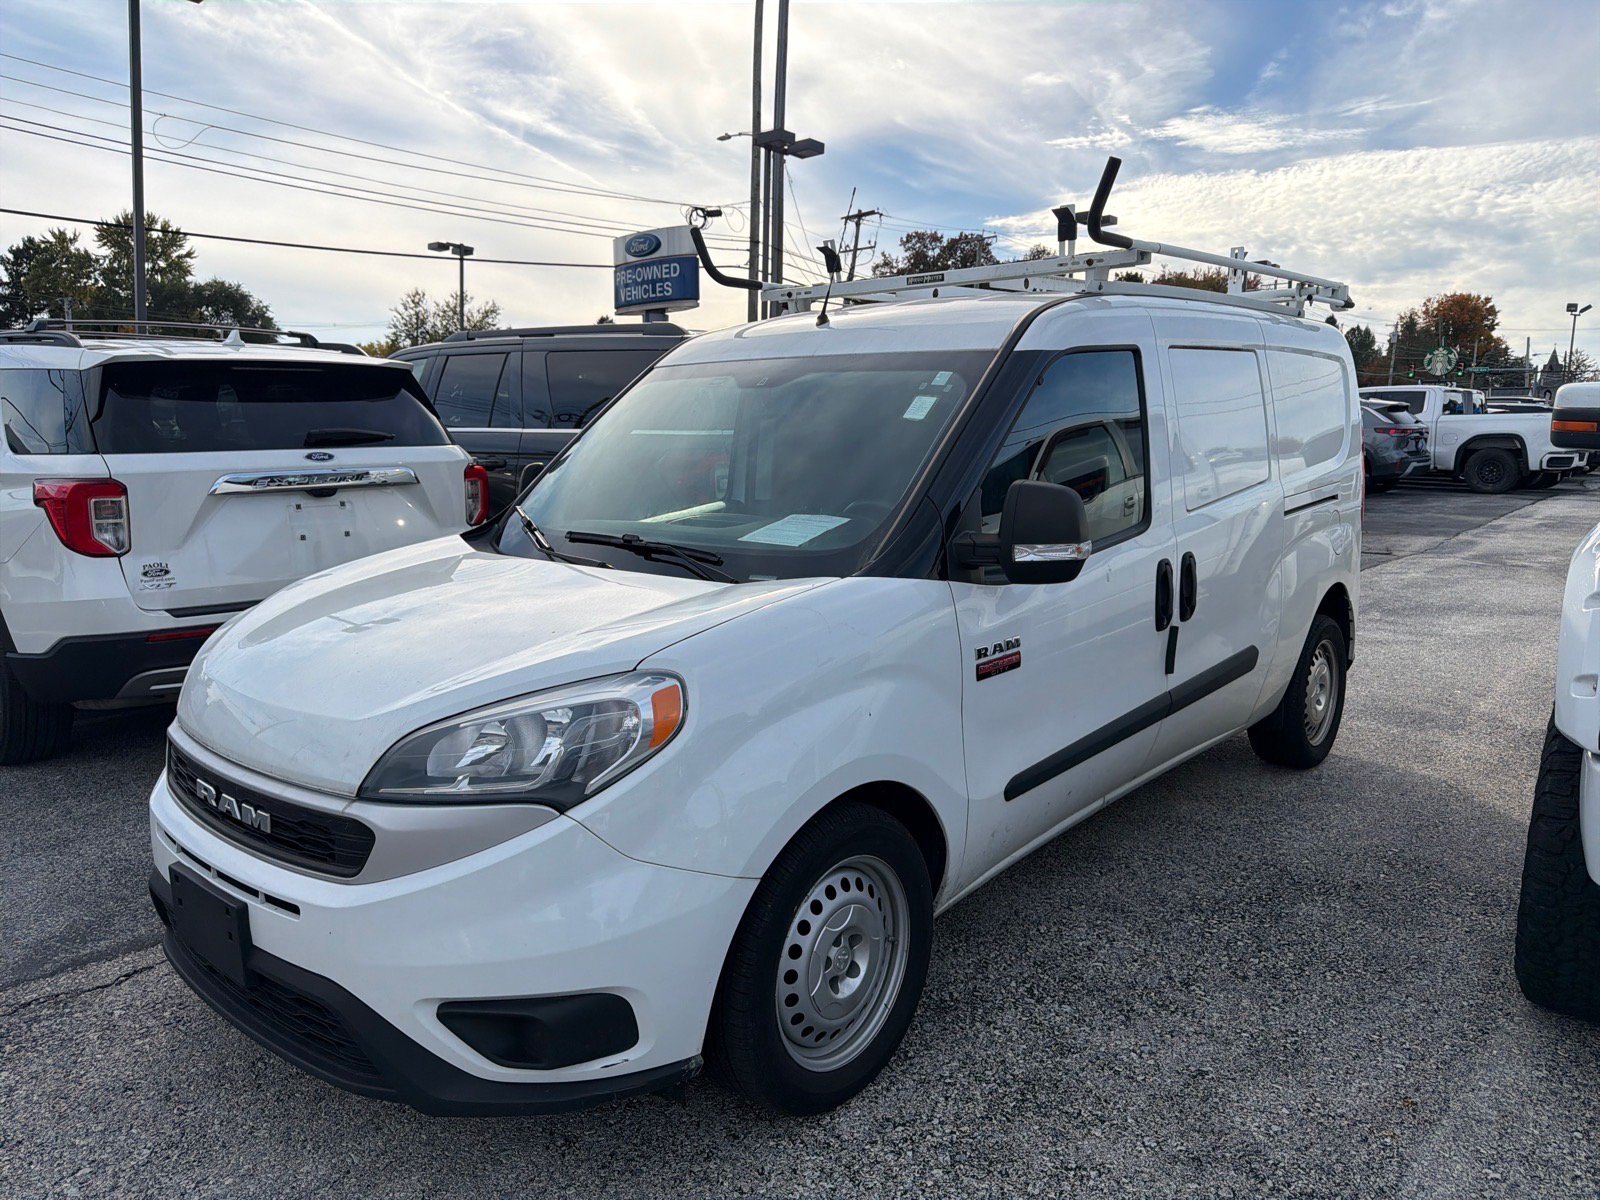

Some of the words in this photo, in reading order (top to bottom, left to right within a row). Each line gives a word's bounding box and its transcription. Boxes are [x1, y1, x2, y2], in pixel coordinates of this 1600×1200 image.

[630, 238, 650, 253] Ford
[616, 263, 680, 286] PRE-OWNED
[620, 281, 673, 302] VEHICLES
[311, 452, 329, 460] Ford
[251, 471, 389, 489] EXPLORER
[142, 562, 169, 570] PAOLI
[975, 636, 1021, 660] RAM
[196, 778, 272, 834] RAM
